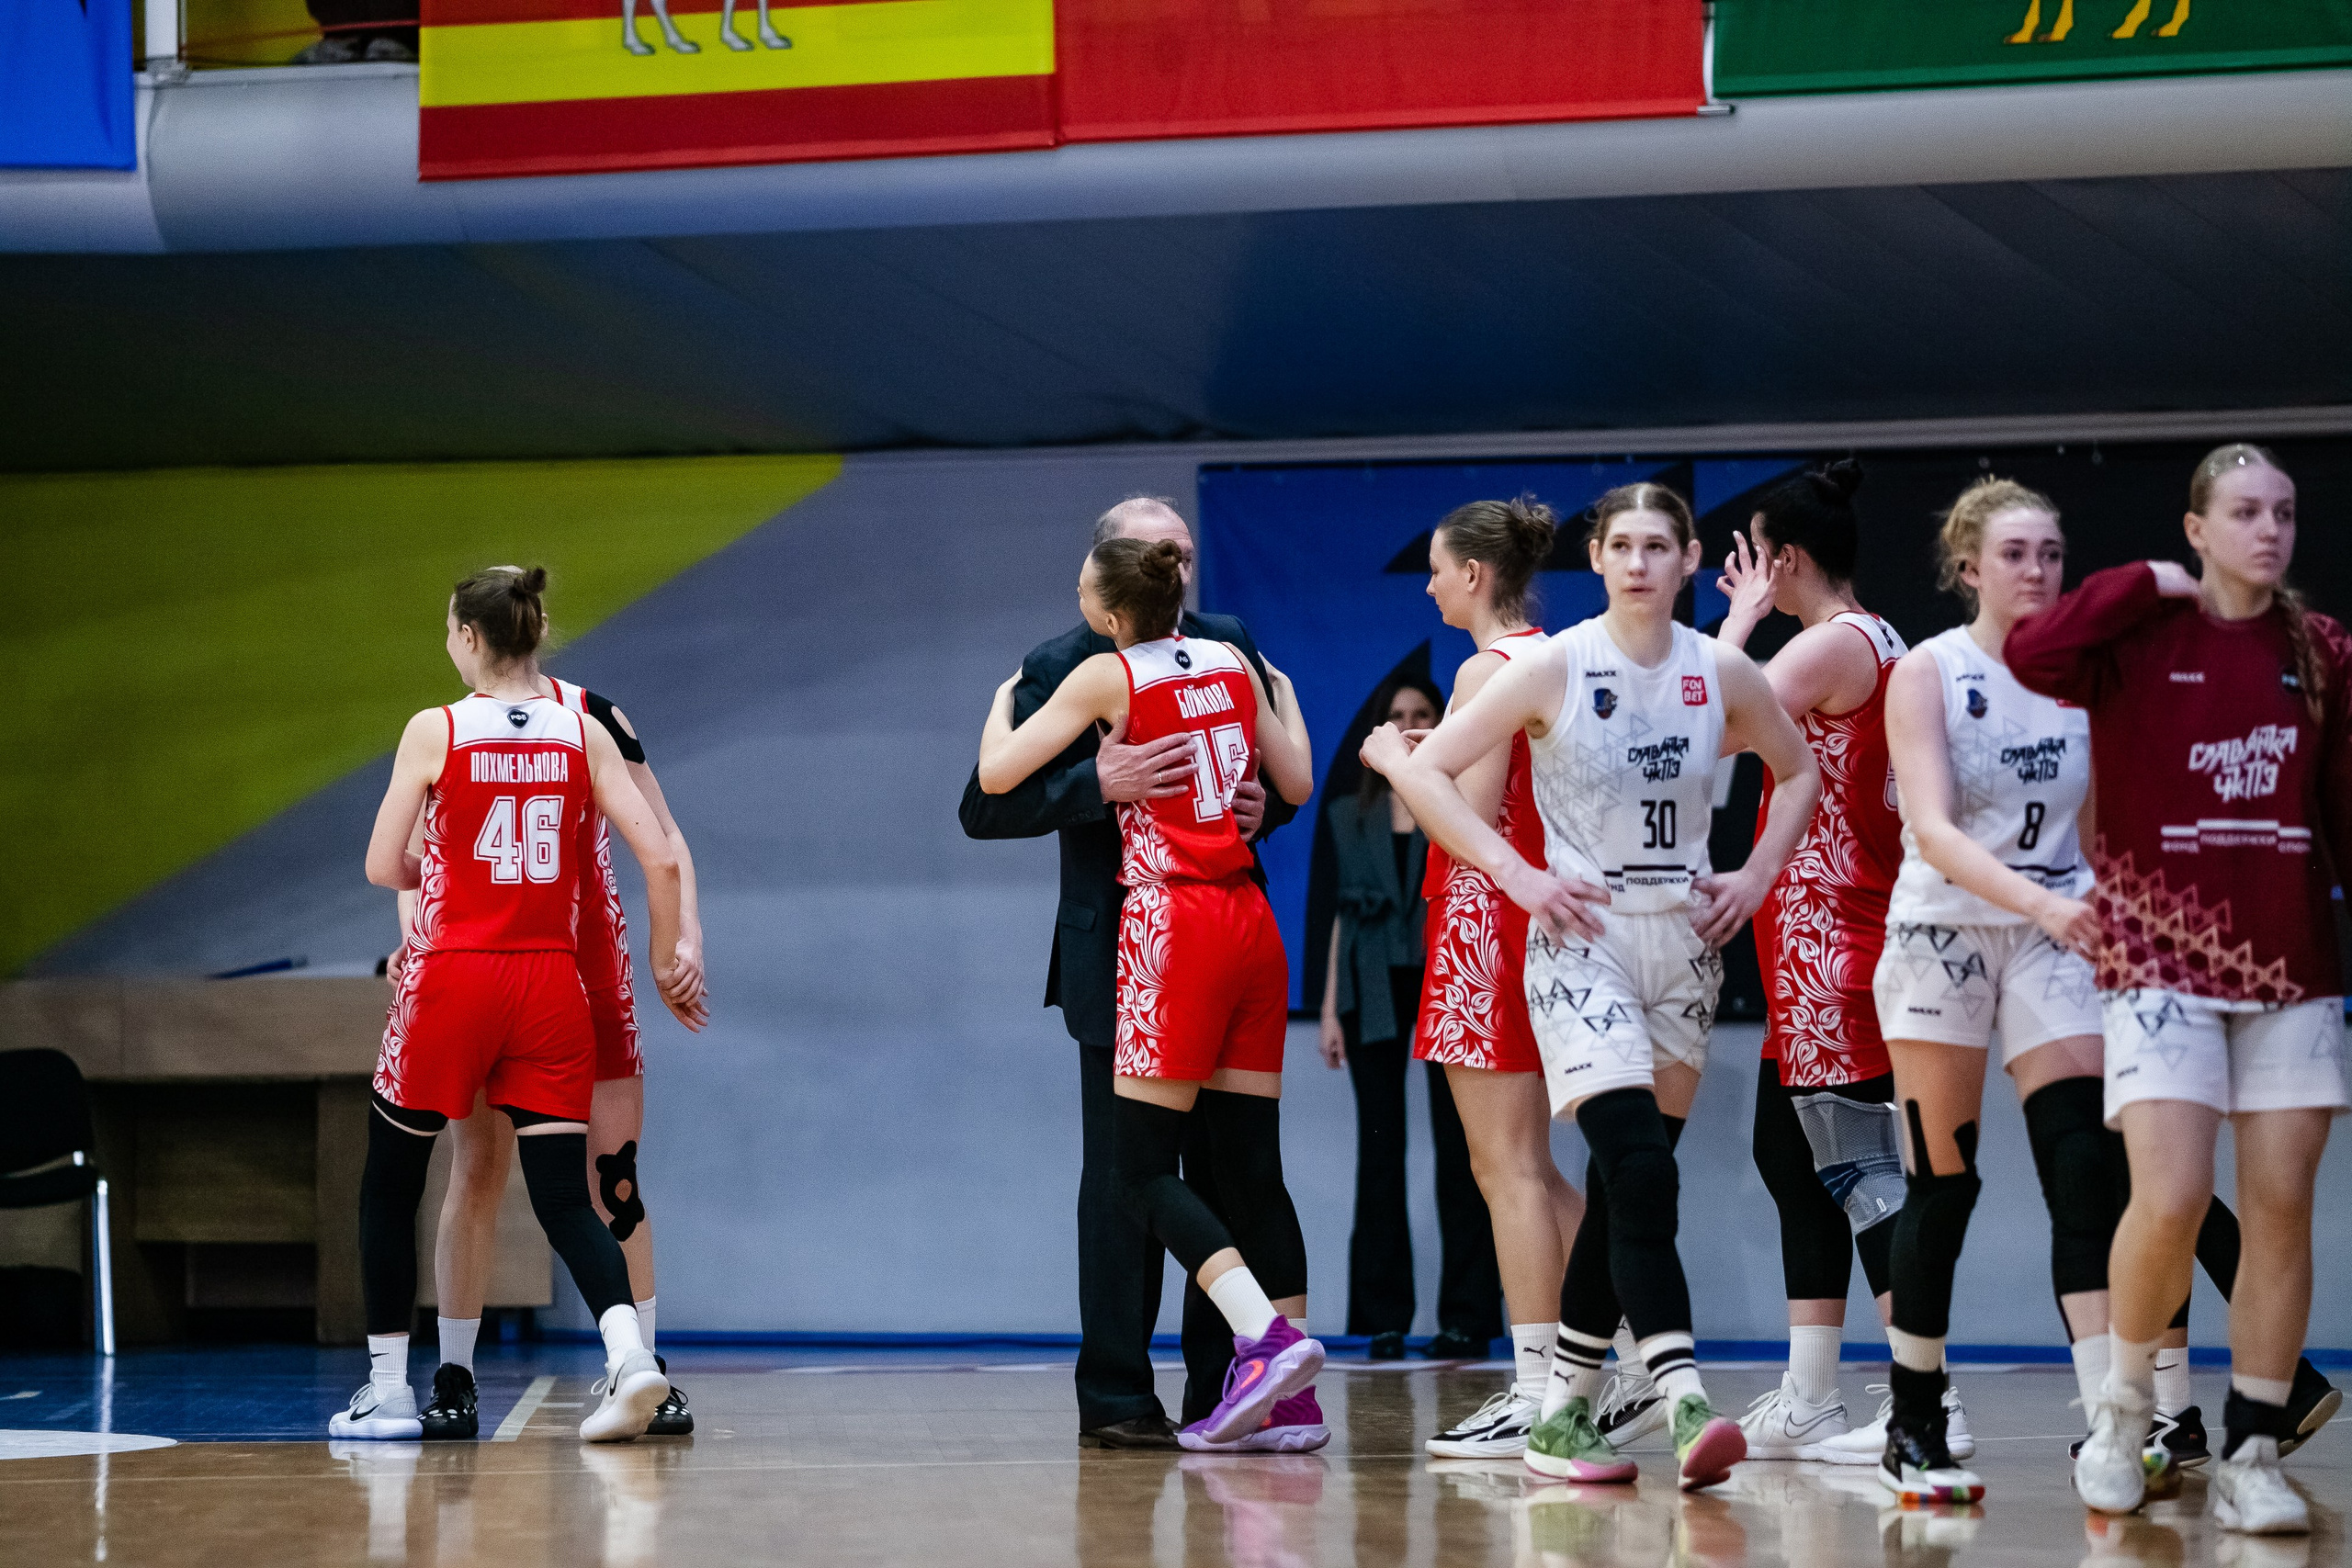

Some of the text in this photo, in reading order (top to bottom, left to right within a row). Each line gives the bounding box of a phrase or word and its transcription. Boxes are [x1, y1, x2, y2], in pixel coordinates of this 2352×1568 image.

[1585, 670, 1617, 678] MAXX
[1682, 679, 1702, 690] FON
[1174, 681, 1235, 719] БОЙКОВА
[1683, 691, 1703, 703] BET
[470, 751, 569, 784] ПОХМЕЛЬНОВА
[1185, 722, 1250, 824] 15
[473, 795, 565, 885] 46
[1640, 800, 1677, 850] 30
[2018, 801, 2046, 851] 8
[1625, 876, 1690, 886] ПОДДЕРЖКИ
[1564, 1062, 1593, 1075] MAXX
